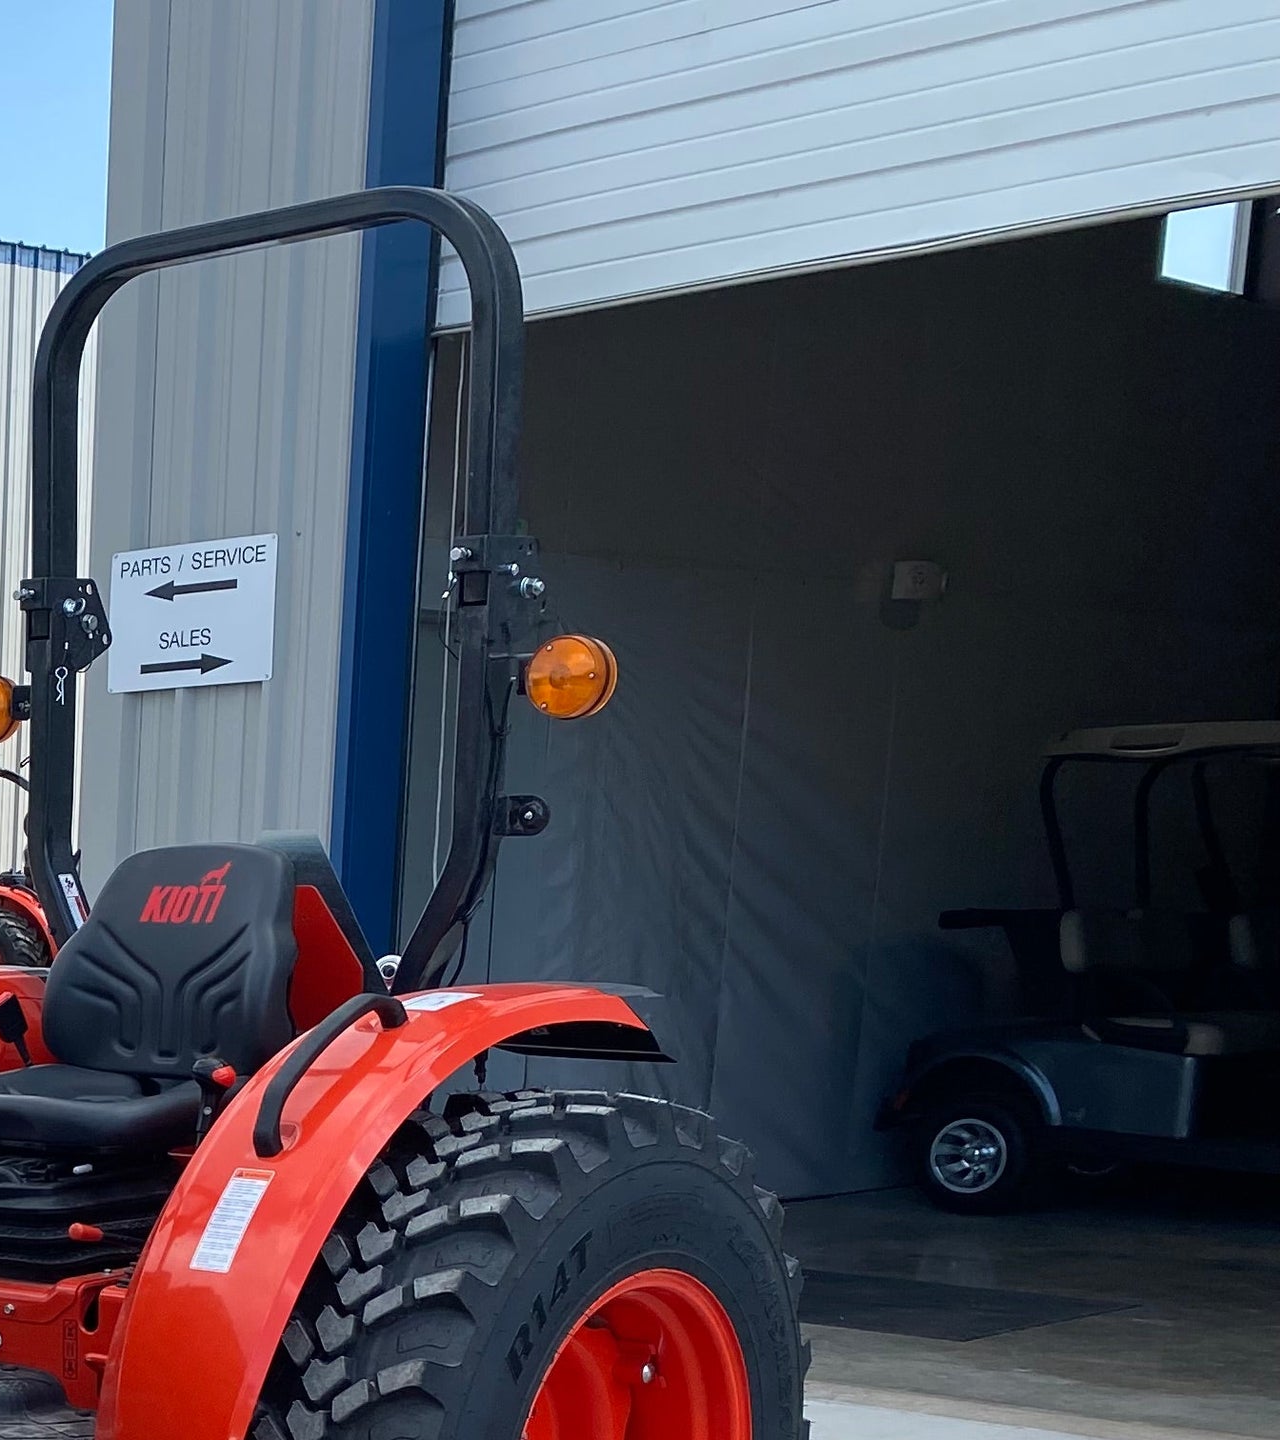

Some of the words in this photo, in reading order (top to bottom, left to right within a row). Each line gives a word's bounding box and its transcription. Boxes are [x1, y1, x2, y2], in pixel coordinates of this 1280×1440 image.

[120, 556, 171, 578] PARTS
[178, 554, 185, 572] /
[191, 545, 267, 570] SERVICE
[159, 628, 211, 649] SALES
[139, 884, 227, 924] KIOTI
[505, 1229, 594, 1383] R14T
